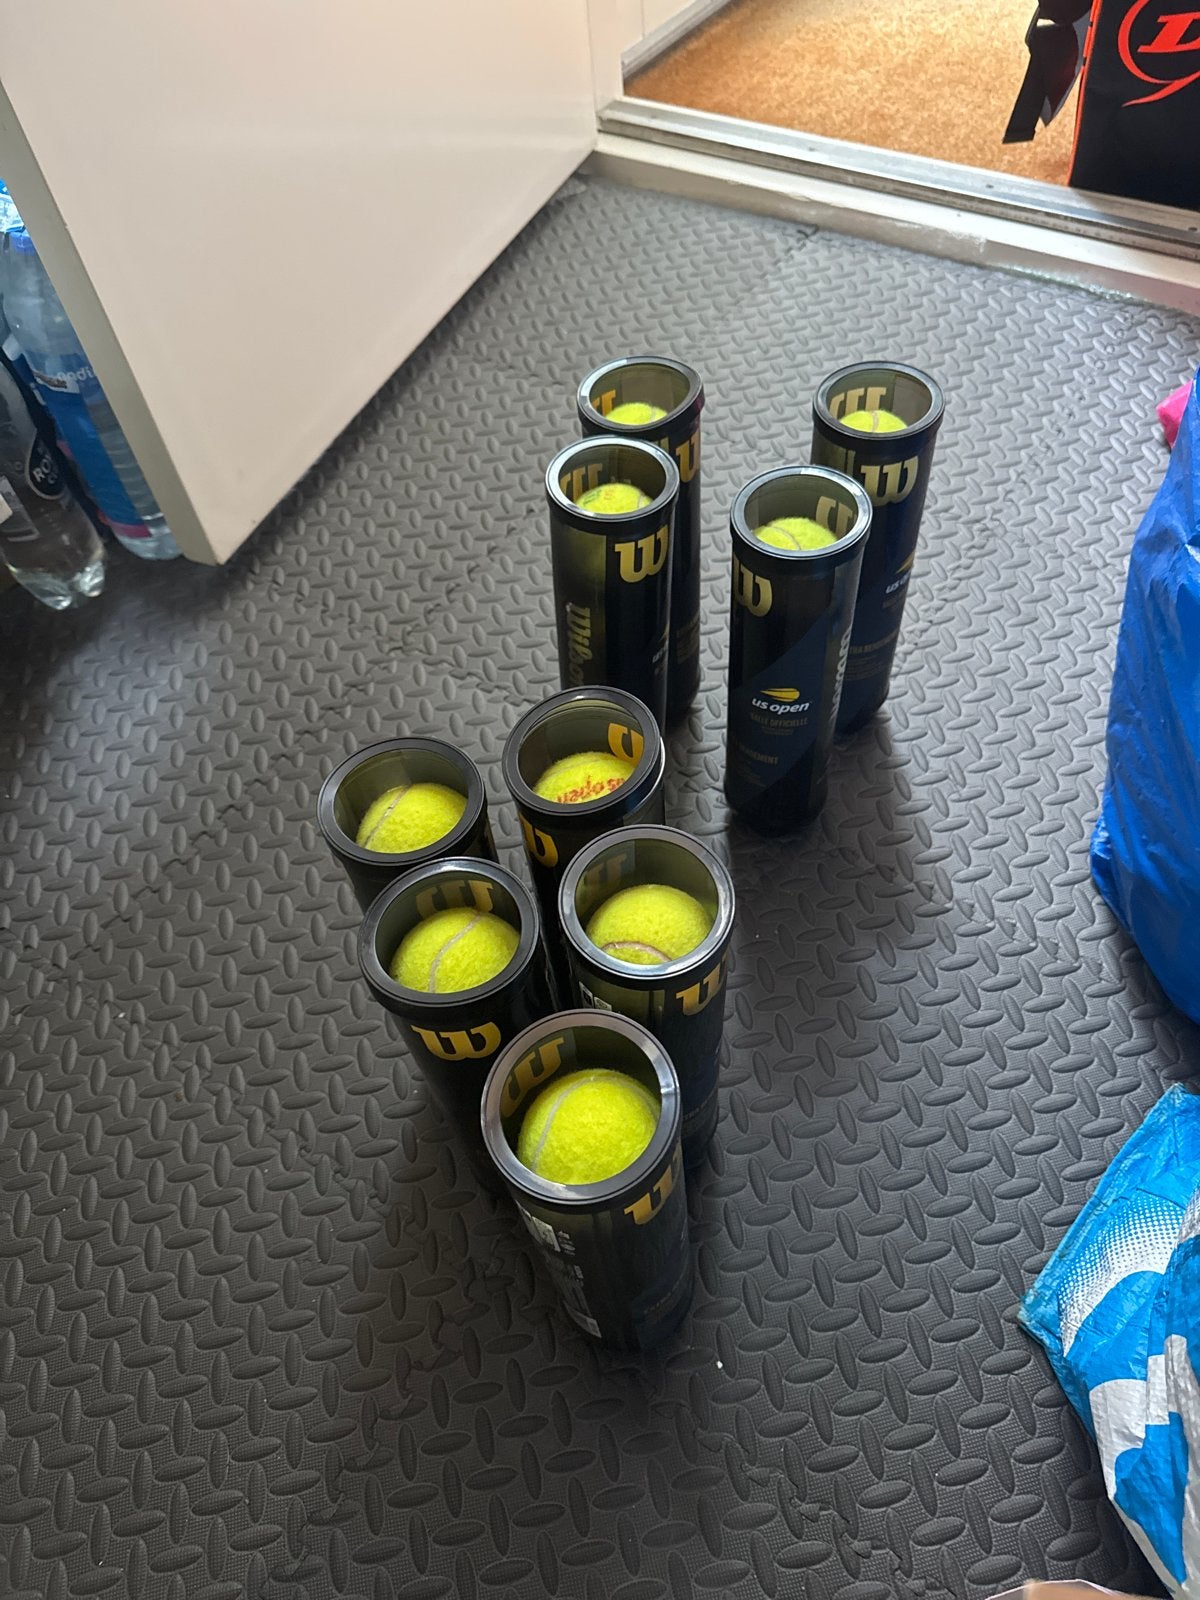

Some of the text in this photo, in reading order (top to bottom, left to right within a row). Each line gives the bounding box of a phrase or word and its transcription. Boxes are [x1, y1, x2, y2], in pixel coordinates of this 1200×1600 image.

[860, 456, 918, 503] W
[614, 525, 669, 583] W
[751, 697, 810, 716] us open
[411, 1022, 501, 1061] W
